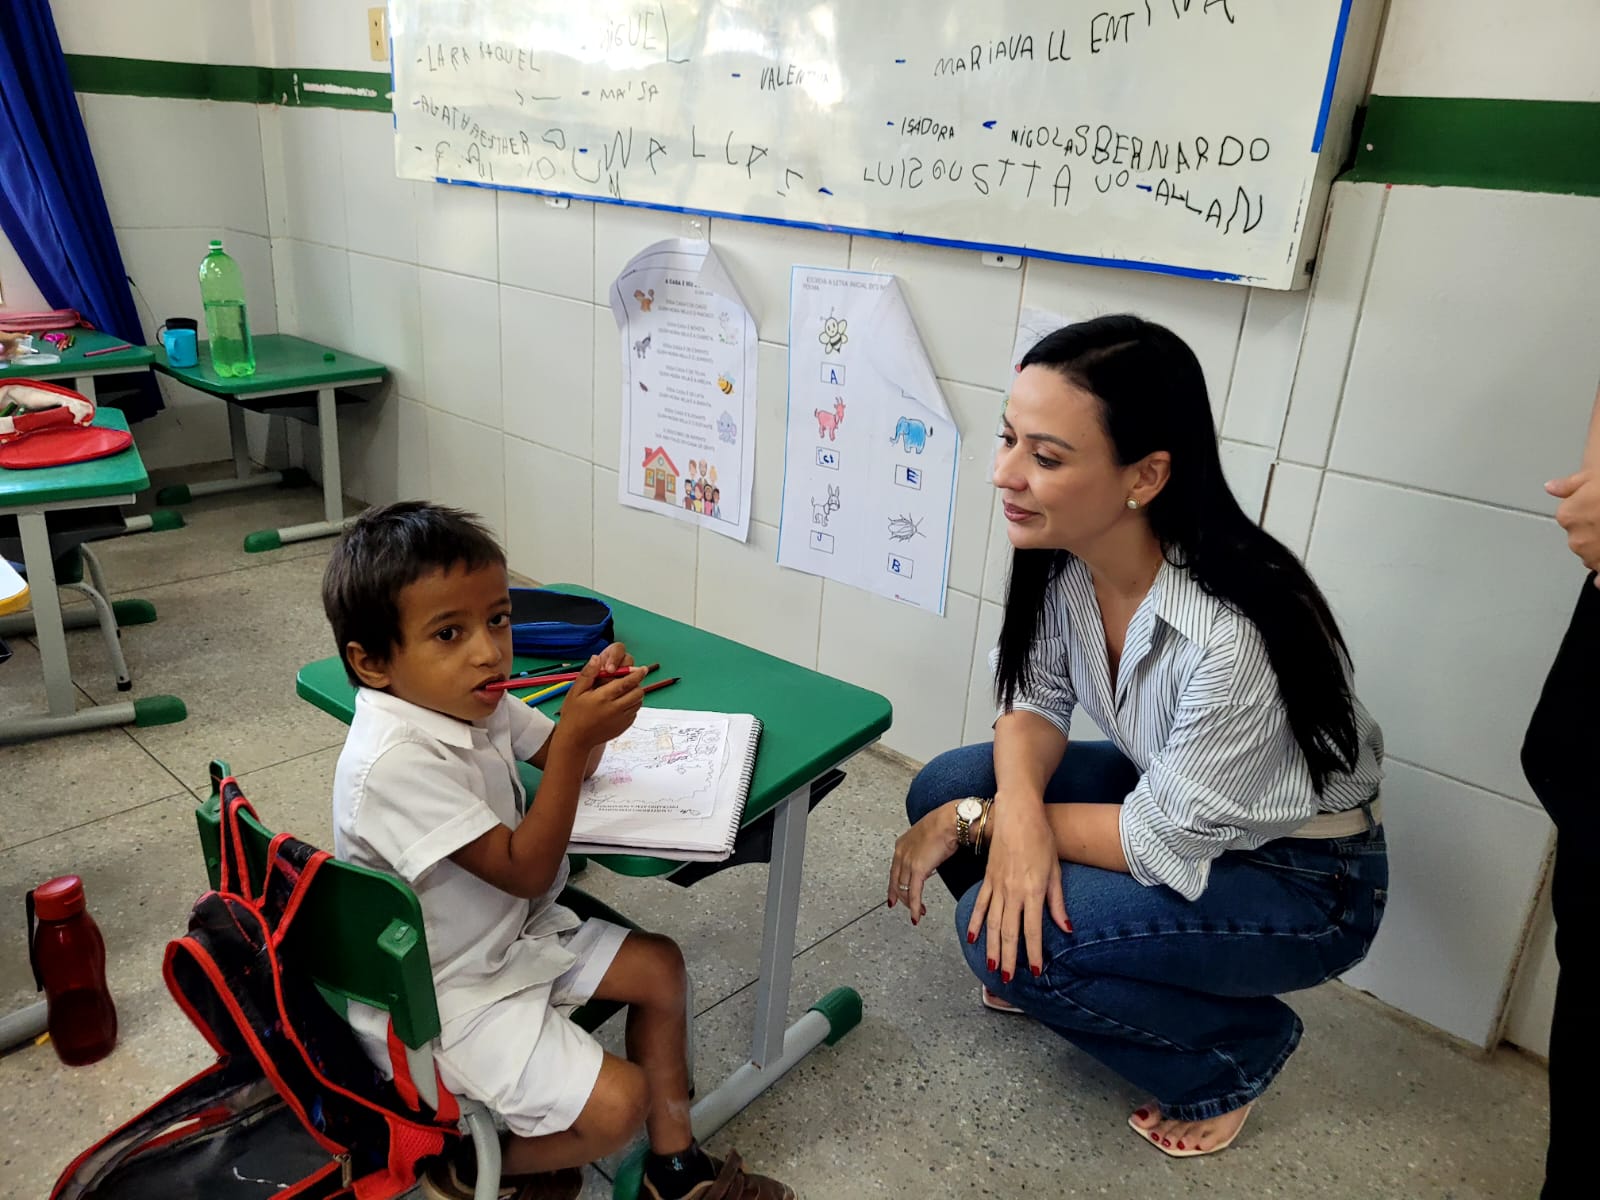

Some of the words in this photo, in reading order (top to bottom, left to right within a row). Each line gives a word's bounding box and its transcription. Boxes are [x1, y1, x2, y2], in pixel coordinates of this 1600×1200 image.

[901, 116, 955, 142] ISADORA
[1154, 177, 1263, 235] ALLAN
[830, 369, 838, 385] A
[906, 467, 919, 485] E
[891, 558, 901, 573] B
